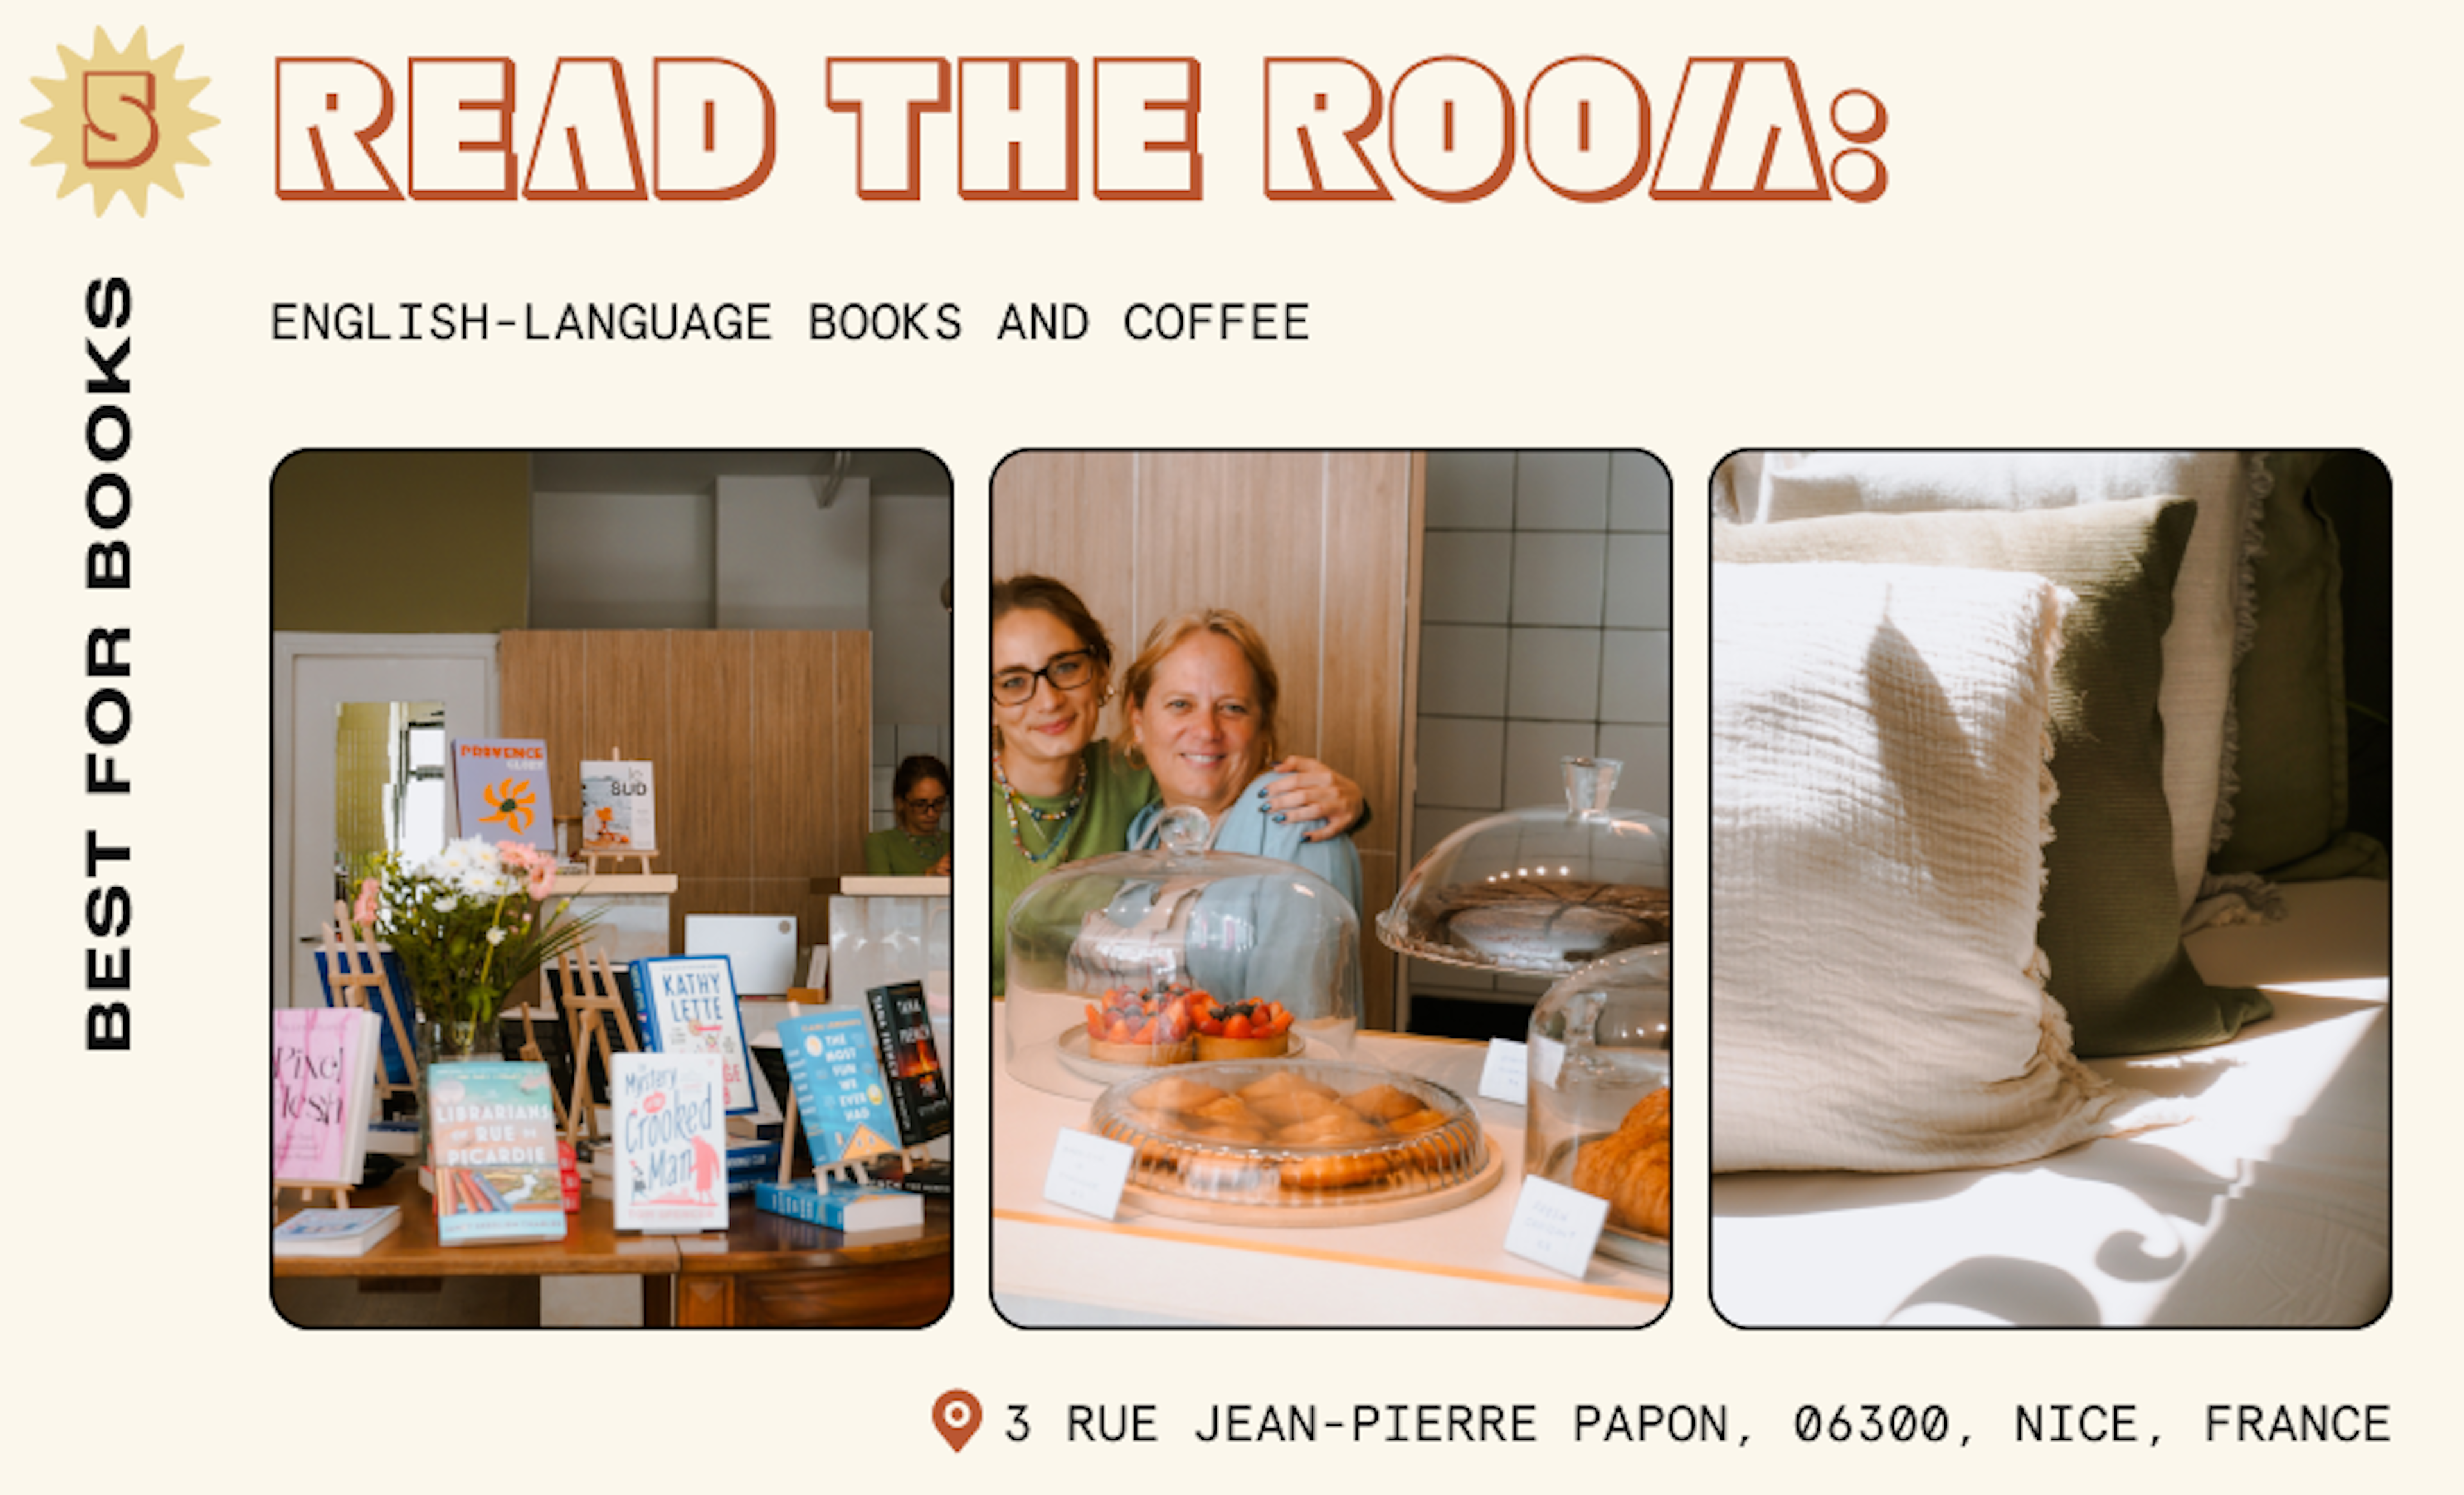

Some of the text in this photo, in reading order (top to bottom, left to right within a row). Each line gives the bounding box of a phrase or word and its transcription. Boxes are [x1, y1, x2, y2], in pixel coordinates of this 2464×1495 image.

[461, 744, 543, 759] PROVENCE
[662, 971, 720, 996] KATHY
[671, 996, 723, 1022] LETTE
[825, 1032, 847, 1046] THE
[825, 1046, 857, 1062] MOST
[625, 1068, 678, 1098] Mystery
[277, 1084, 343, 1127] lesh
[435, 1103, 550, 1123] LIBRARIANS
[844, 1107, 871, 1122] HAD
[625, 1082, 712, 1154] Crooked
[475, 1125, 516, 1143] RUE
[447, 1146, 547, 1166] PICARDIE
[648, 1149, 692, 1191] Man
